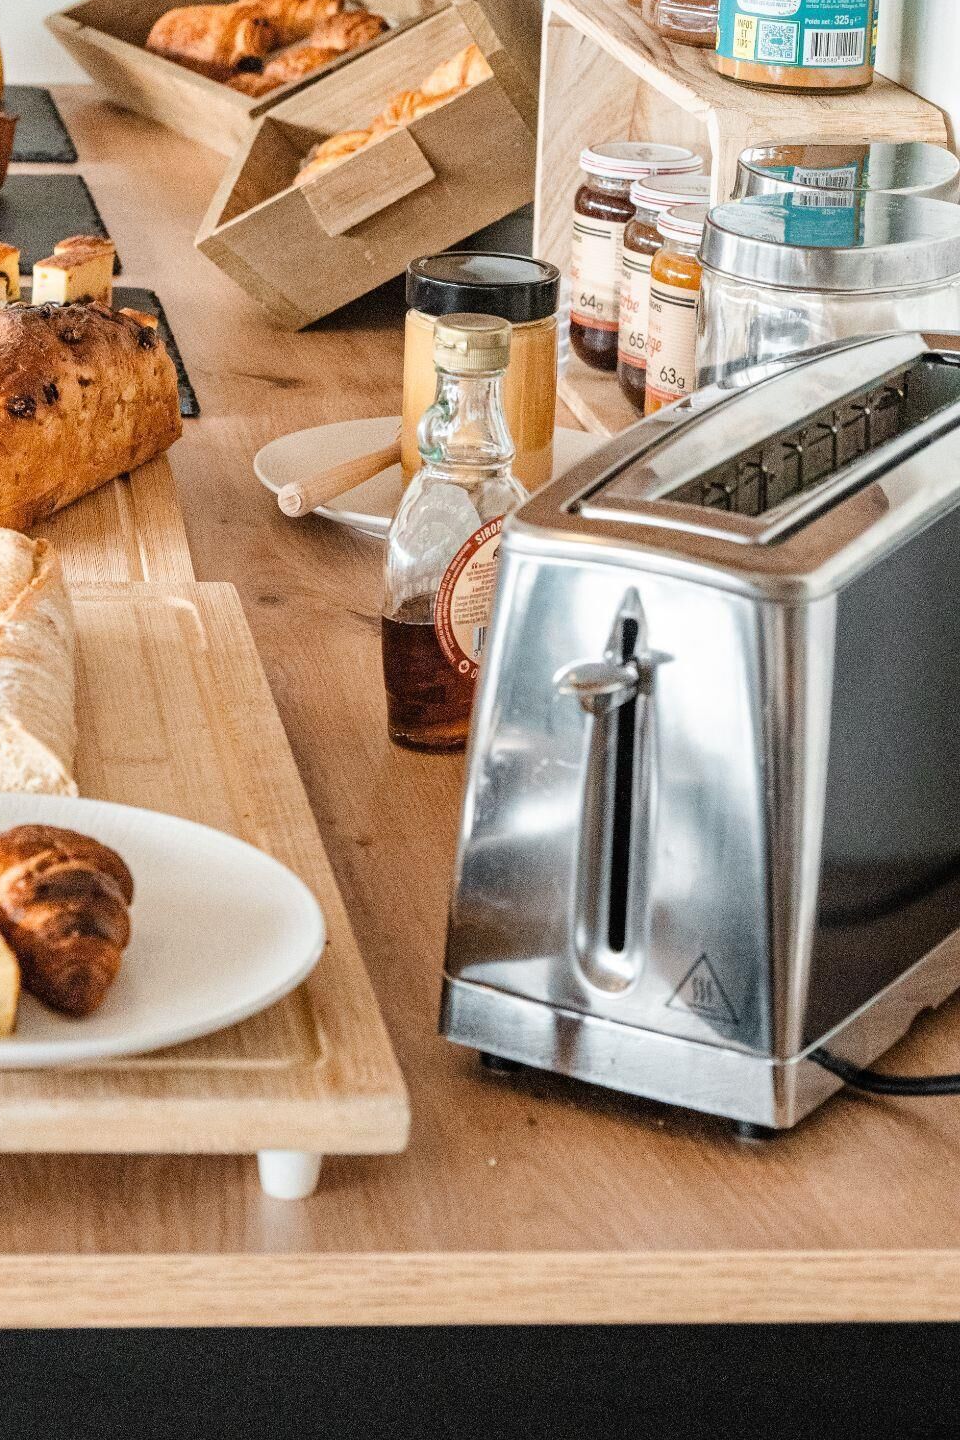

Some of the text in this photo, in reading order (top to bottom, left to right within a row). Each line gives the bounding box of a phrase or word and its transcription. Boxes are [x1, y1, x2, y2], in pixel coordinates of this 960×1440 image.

[741, 29, 748, 39] ET
[580, 293, 604, 313] 64g
[659, 366, 686, 389] 63g
[475, 519, 502, 545] SIROP
